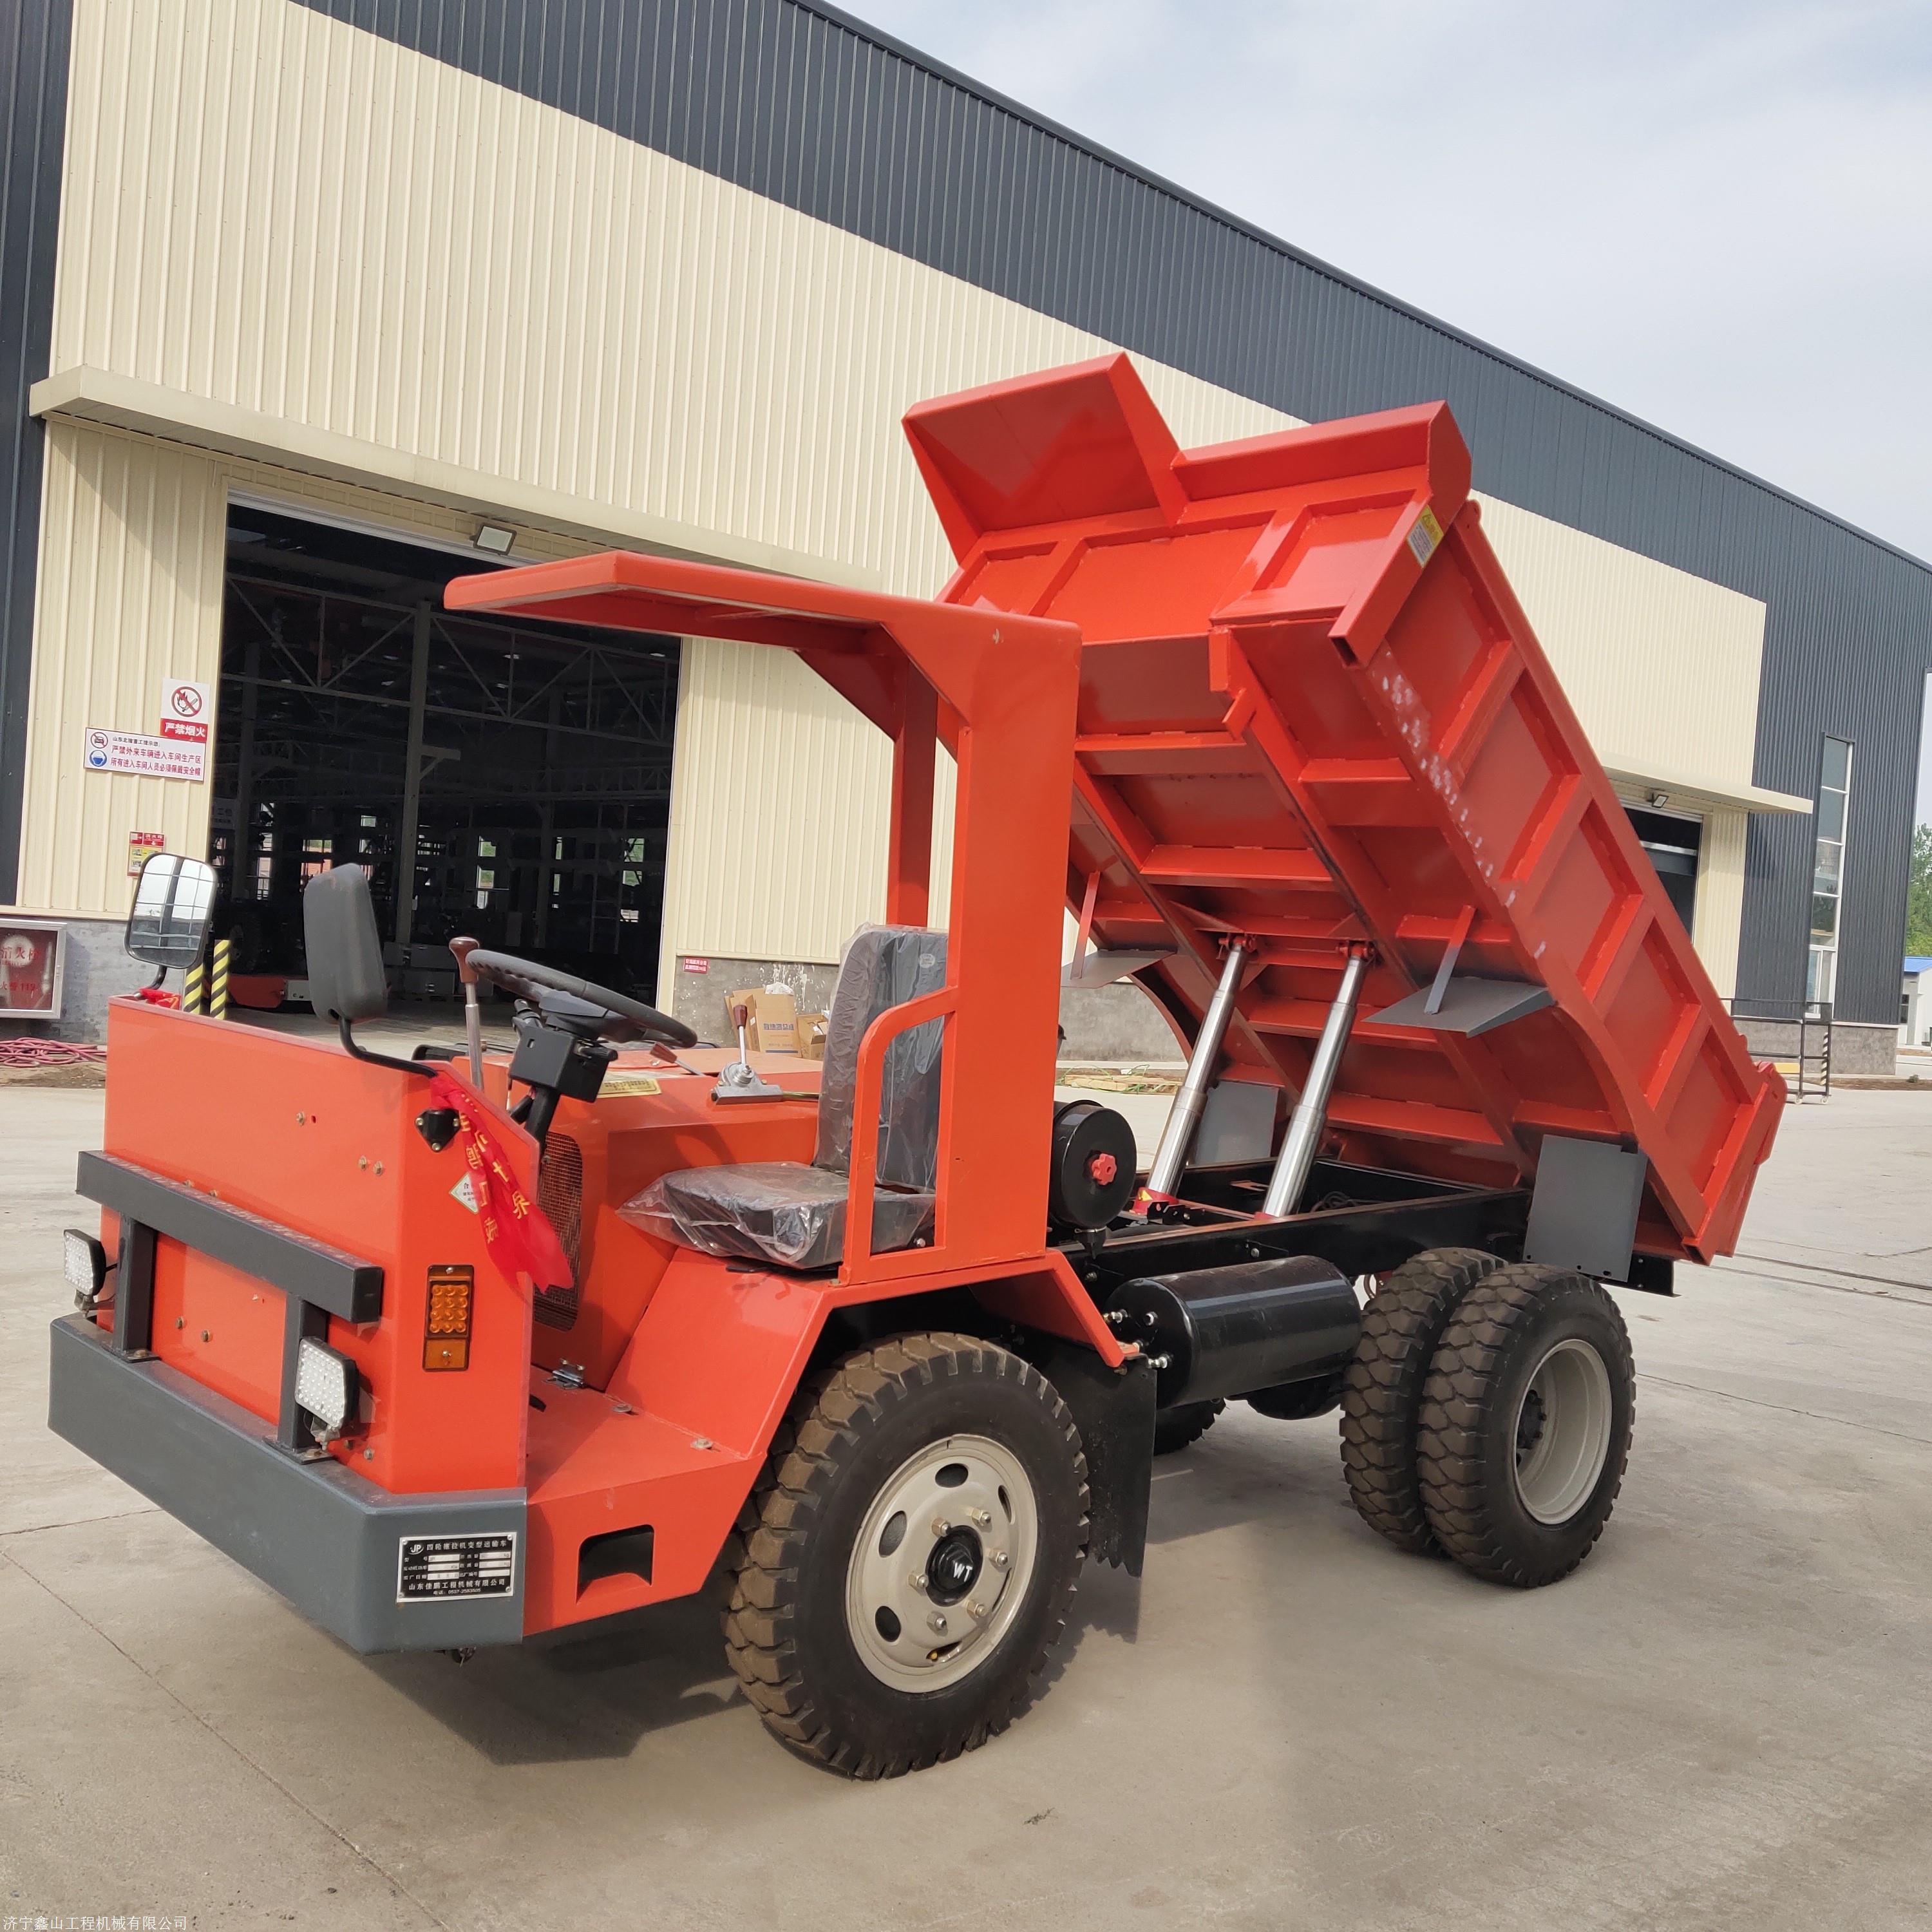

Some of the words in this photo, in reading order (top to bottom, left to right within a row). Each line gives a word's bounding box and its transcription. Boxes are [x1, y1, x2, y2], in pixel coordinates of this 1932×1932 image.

[164, 722, 206, 737] 严禁烟火
[111, 745, 202, 764] 严禁外来车辆进入车间生产区
[110, 757, 201, 776] 所有进入车间人员必须佩戴安全帽
[426, 1540, 507, 1551] 四轮拖拉机变型运输车
[953, 1562, 973, 1582] WT
[408, 1578, 506, 1590] 山东佳鹏工程机械有限公司
